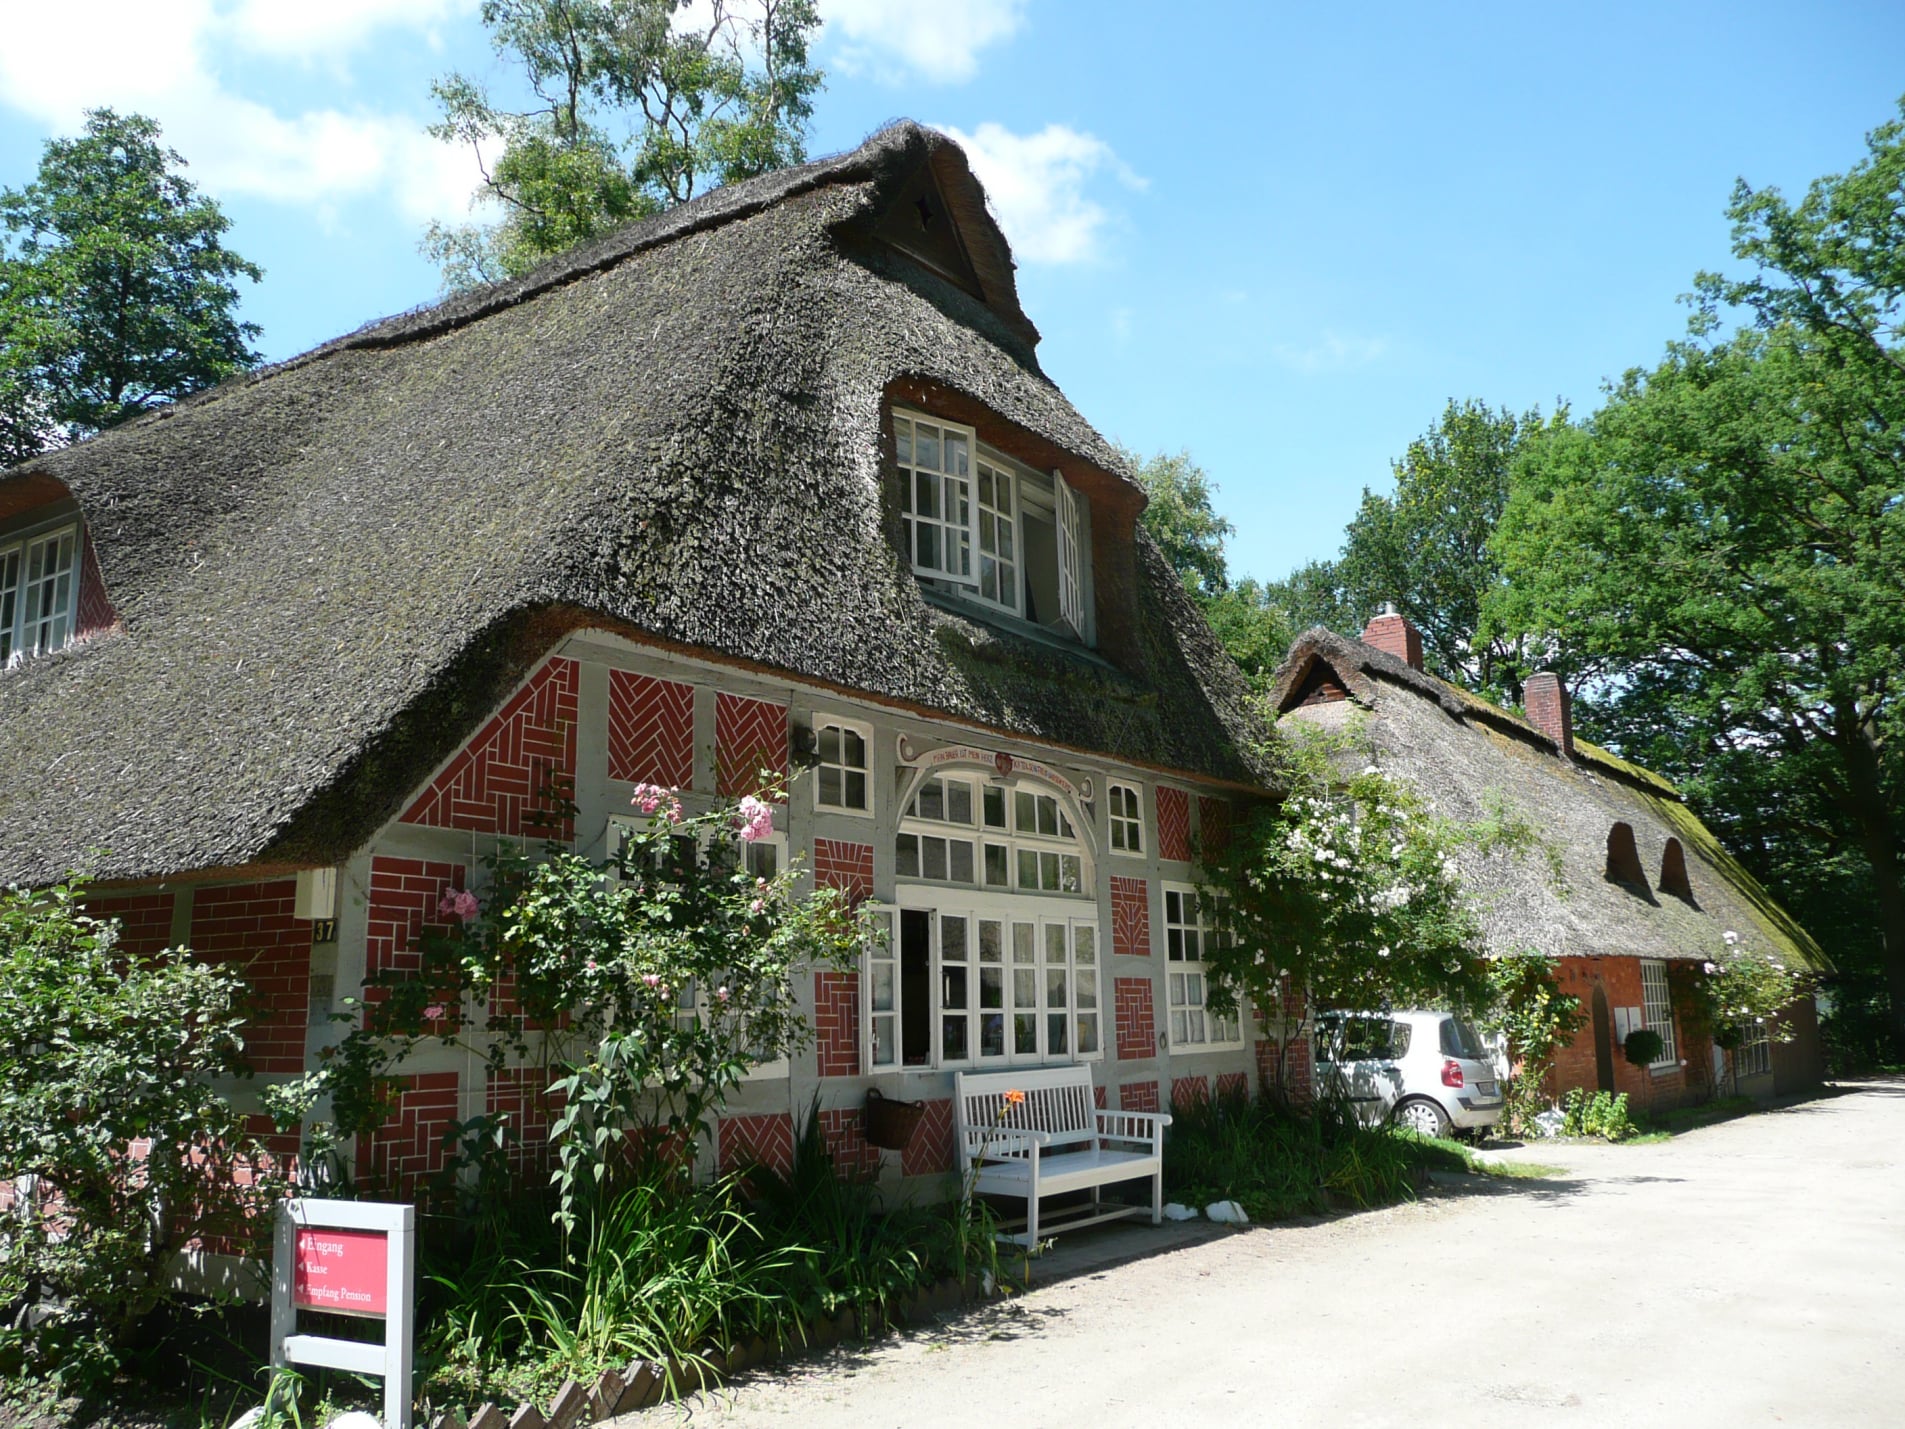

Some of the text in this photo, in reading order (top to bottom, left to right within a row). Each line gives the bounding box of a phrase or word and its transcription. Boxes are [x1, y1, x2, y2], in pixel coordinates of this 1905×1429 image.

[316, 921, 334, 941] 37
[307, 1237, 344, 1257] Eingang
[306, 1261, 328, 1274] Kasse
[340, 1287, 371, 1302] Pension
